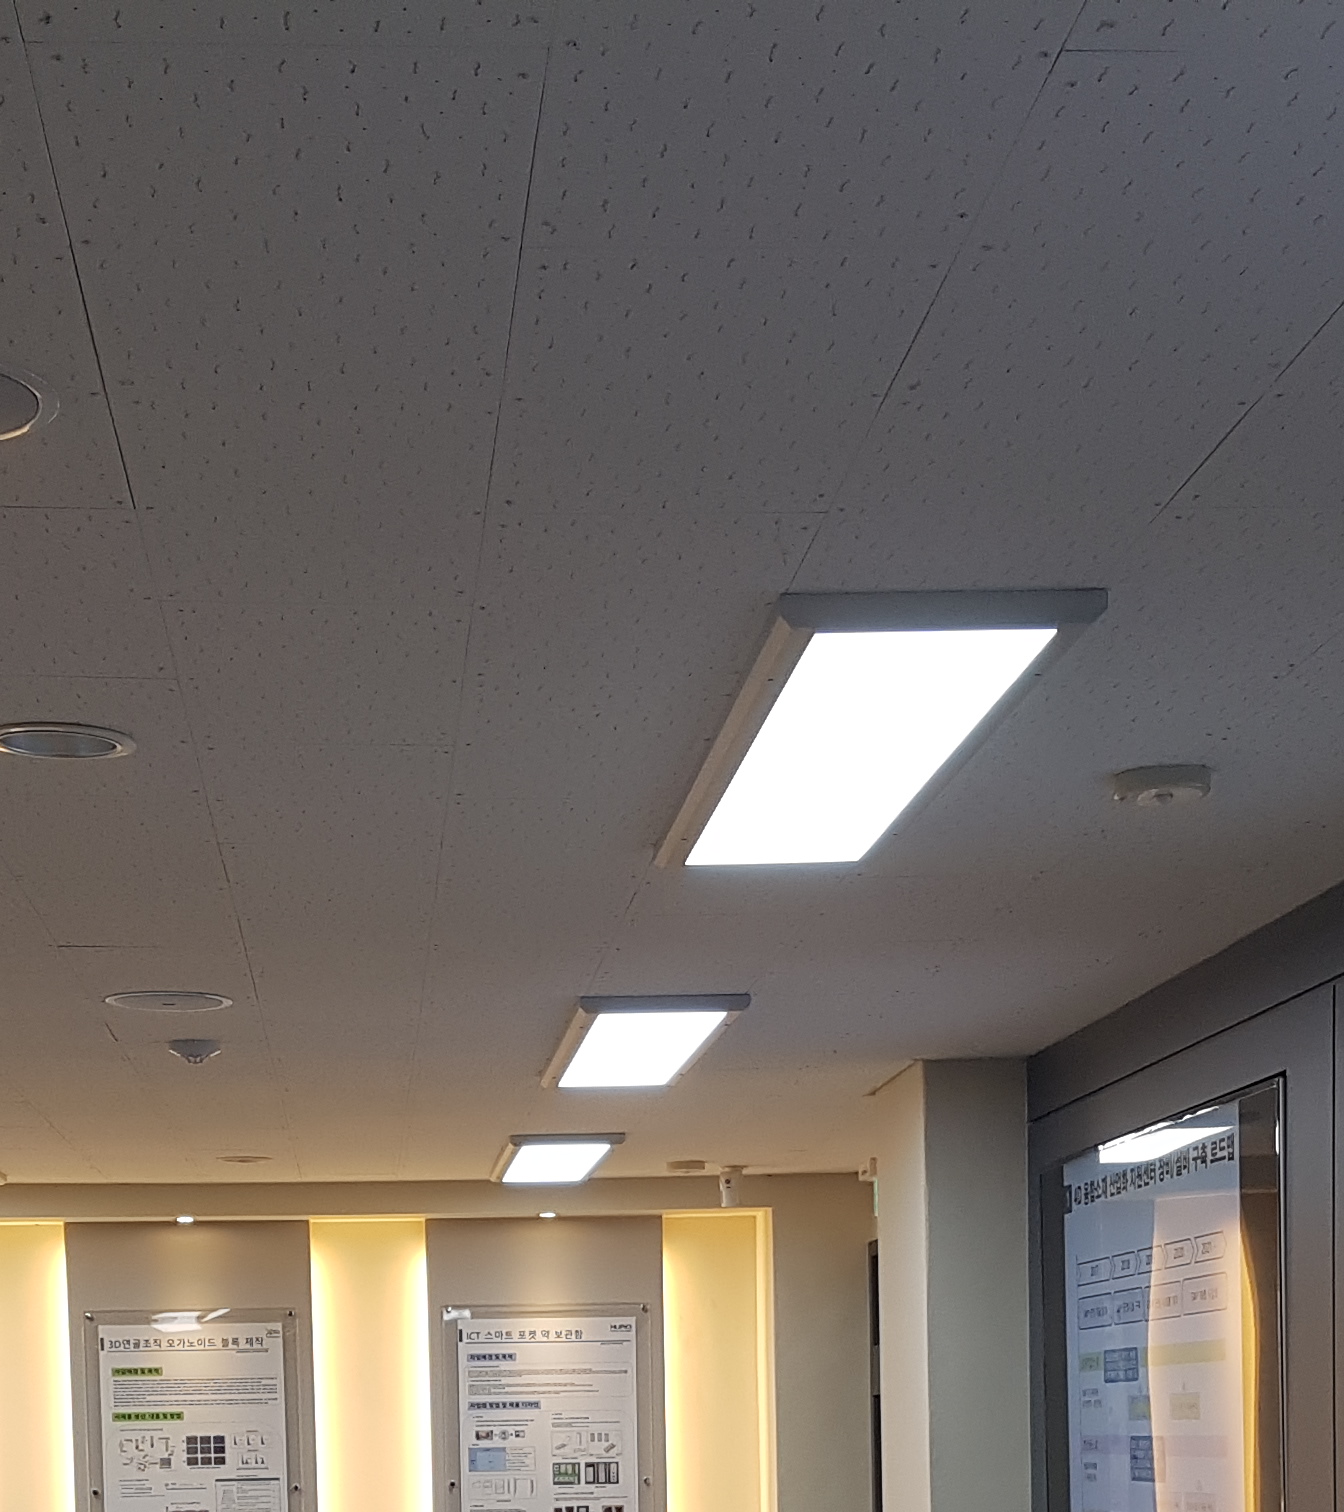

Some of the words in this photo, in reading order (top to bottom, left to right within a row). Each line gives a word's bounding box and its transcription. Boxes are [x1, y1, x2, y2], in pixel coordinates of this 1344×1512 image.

[466, 1332, 481, 1341] ICT
[484, 1330, 514, 1341] 스마트
[554, 1329, 584, 1340] 보관함
[108, 1338, 162, 1350] 3D연골조직
[166, 1337, 218, 1349] 오가노이드
[244, 1336, 265, 1348] 제작
